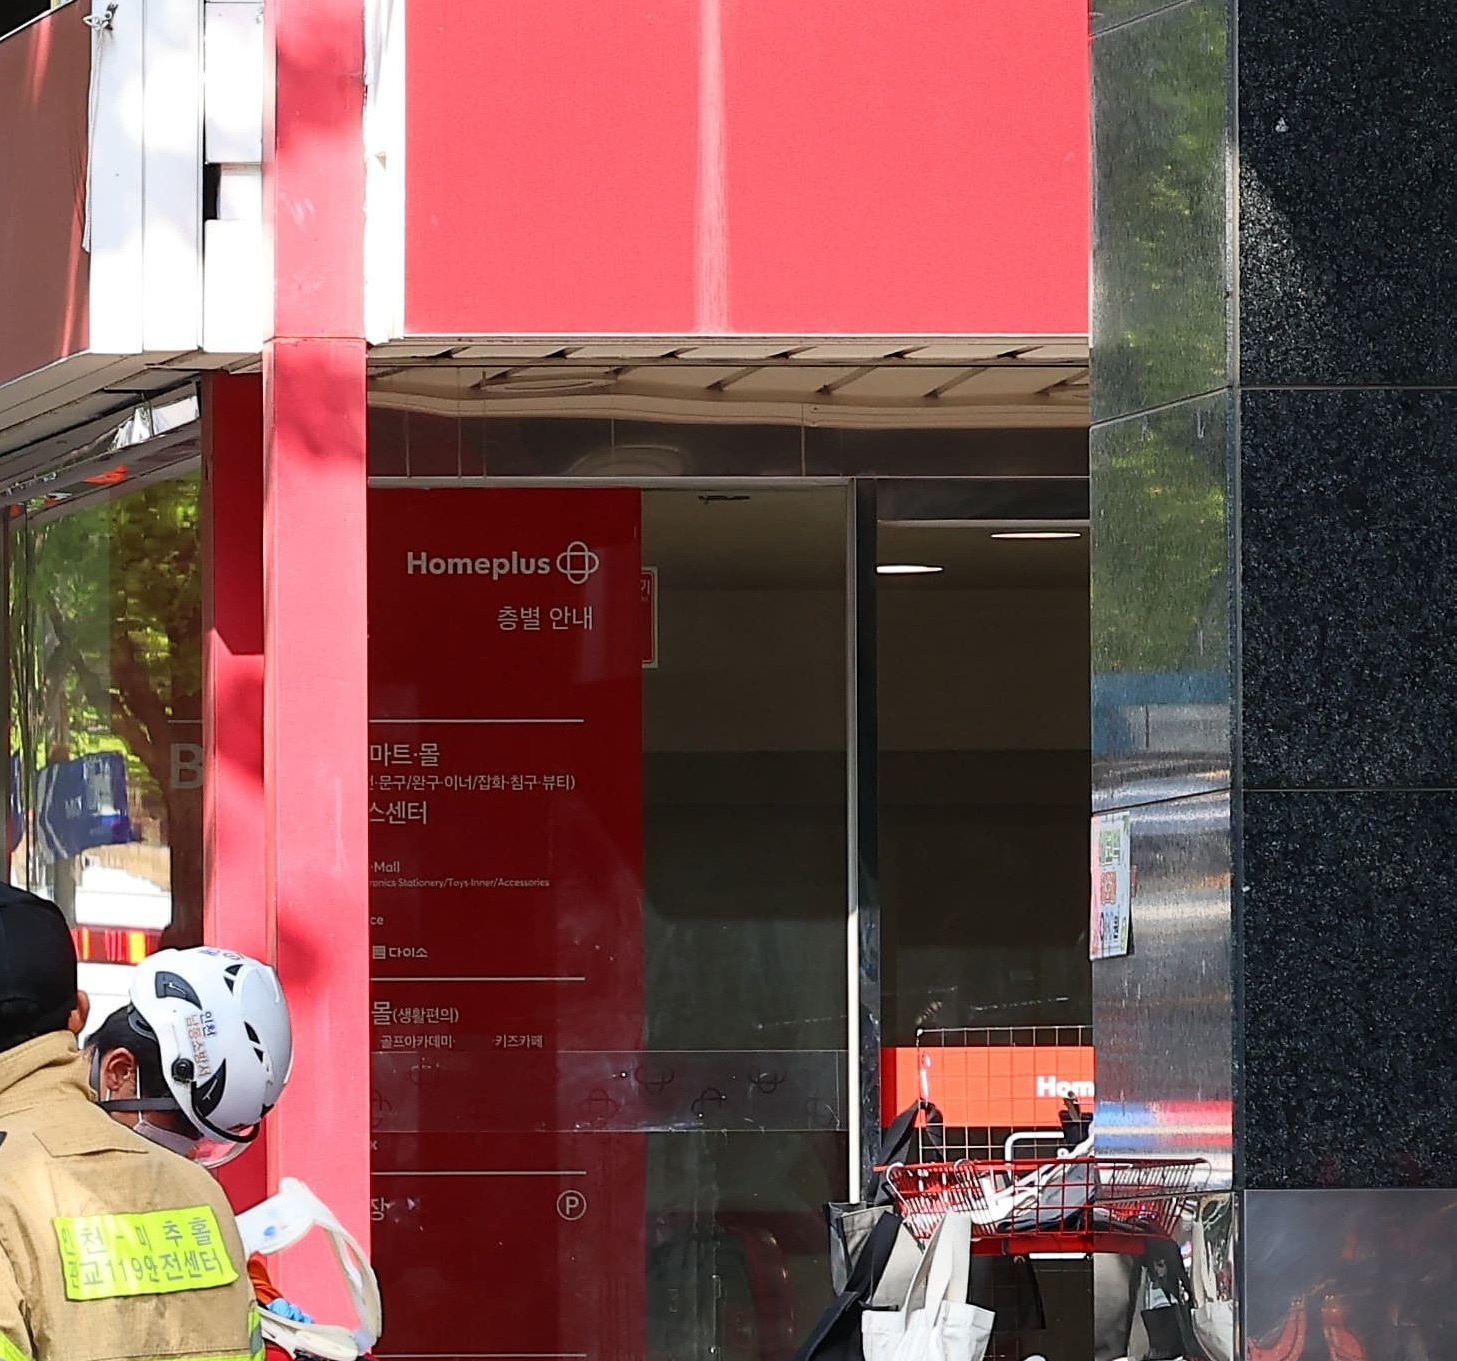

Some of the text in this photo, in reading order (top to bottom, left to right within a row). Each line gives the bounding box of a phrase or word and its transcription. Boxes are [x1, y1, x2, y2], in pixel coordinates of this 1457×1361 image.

[406, 551, 550, 580] Homeplus
[497, 606, 594, 631] 층별 안내
[389, 947, 428, 959] 다이소
